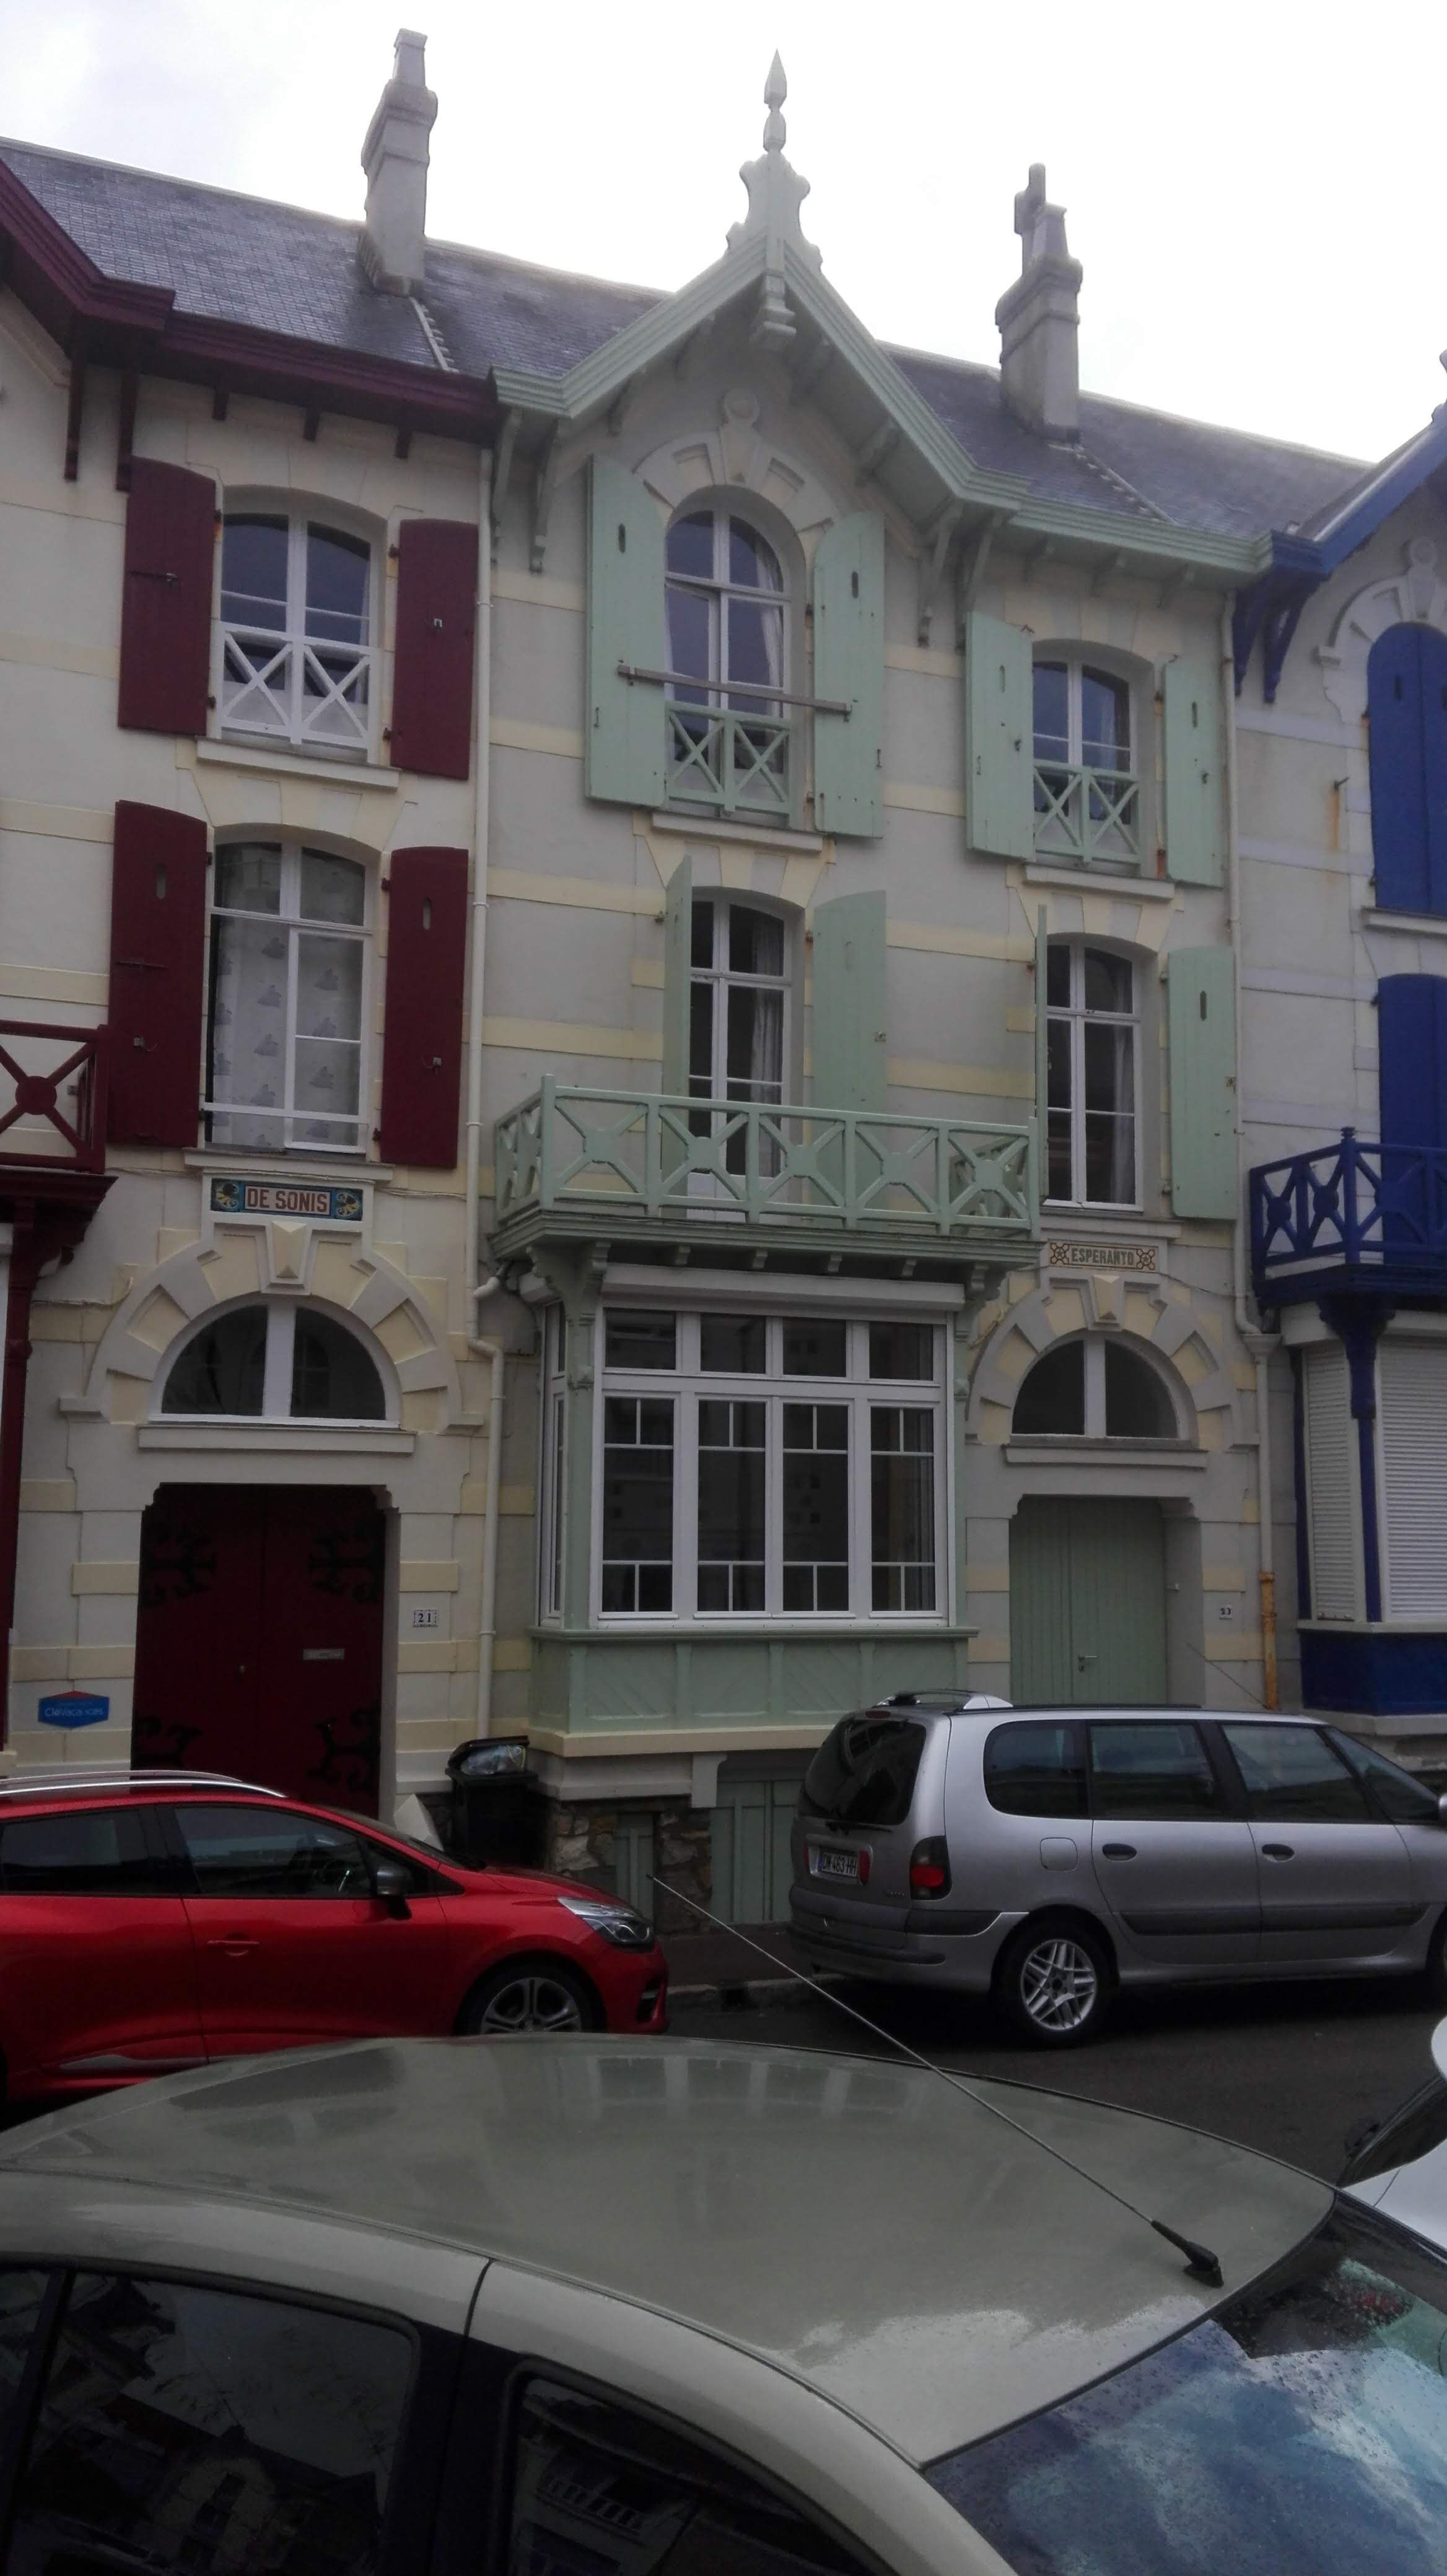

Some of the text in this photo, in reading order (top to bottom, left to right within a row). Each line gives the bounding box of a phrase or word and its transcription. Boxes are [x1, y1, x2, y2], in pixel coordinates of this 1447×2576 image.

[247, 1188, 328, 1212] DE SONIS
[1071, 1248, 1135, 1265] ESPERANTO
[417, 1612, 432, 1623] 21
[1220, 1607, 1232, 1615] 23
